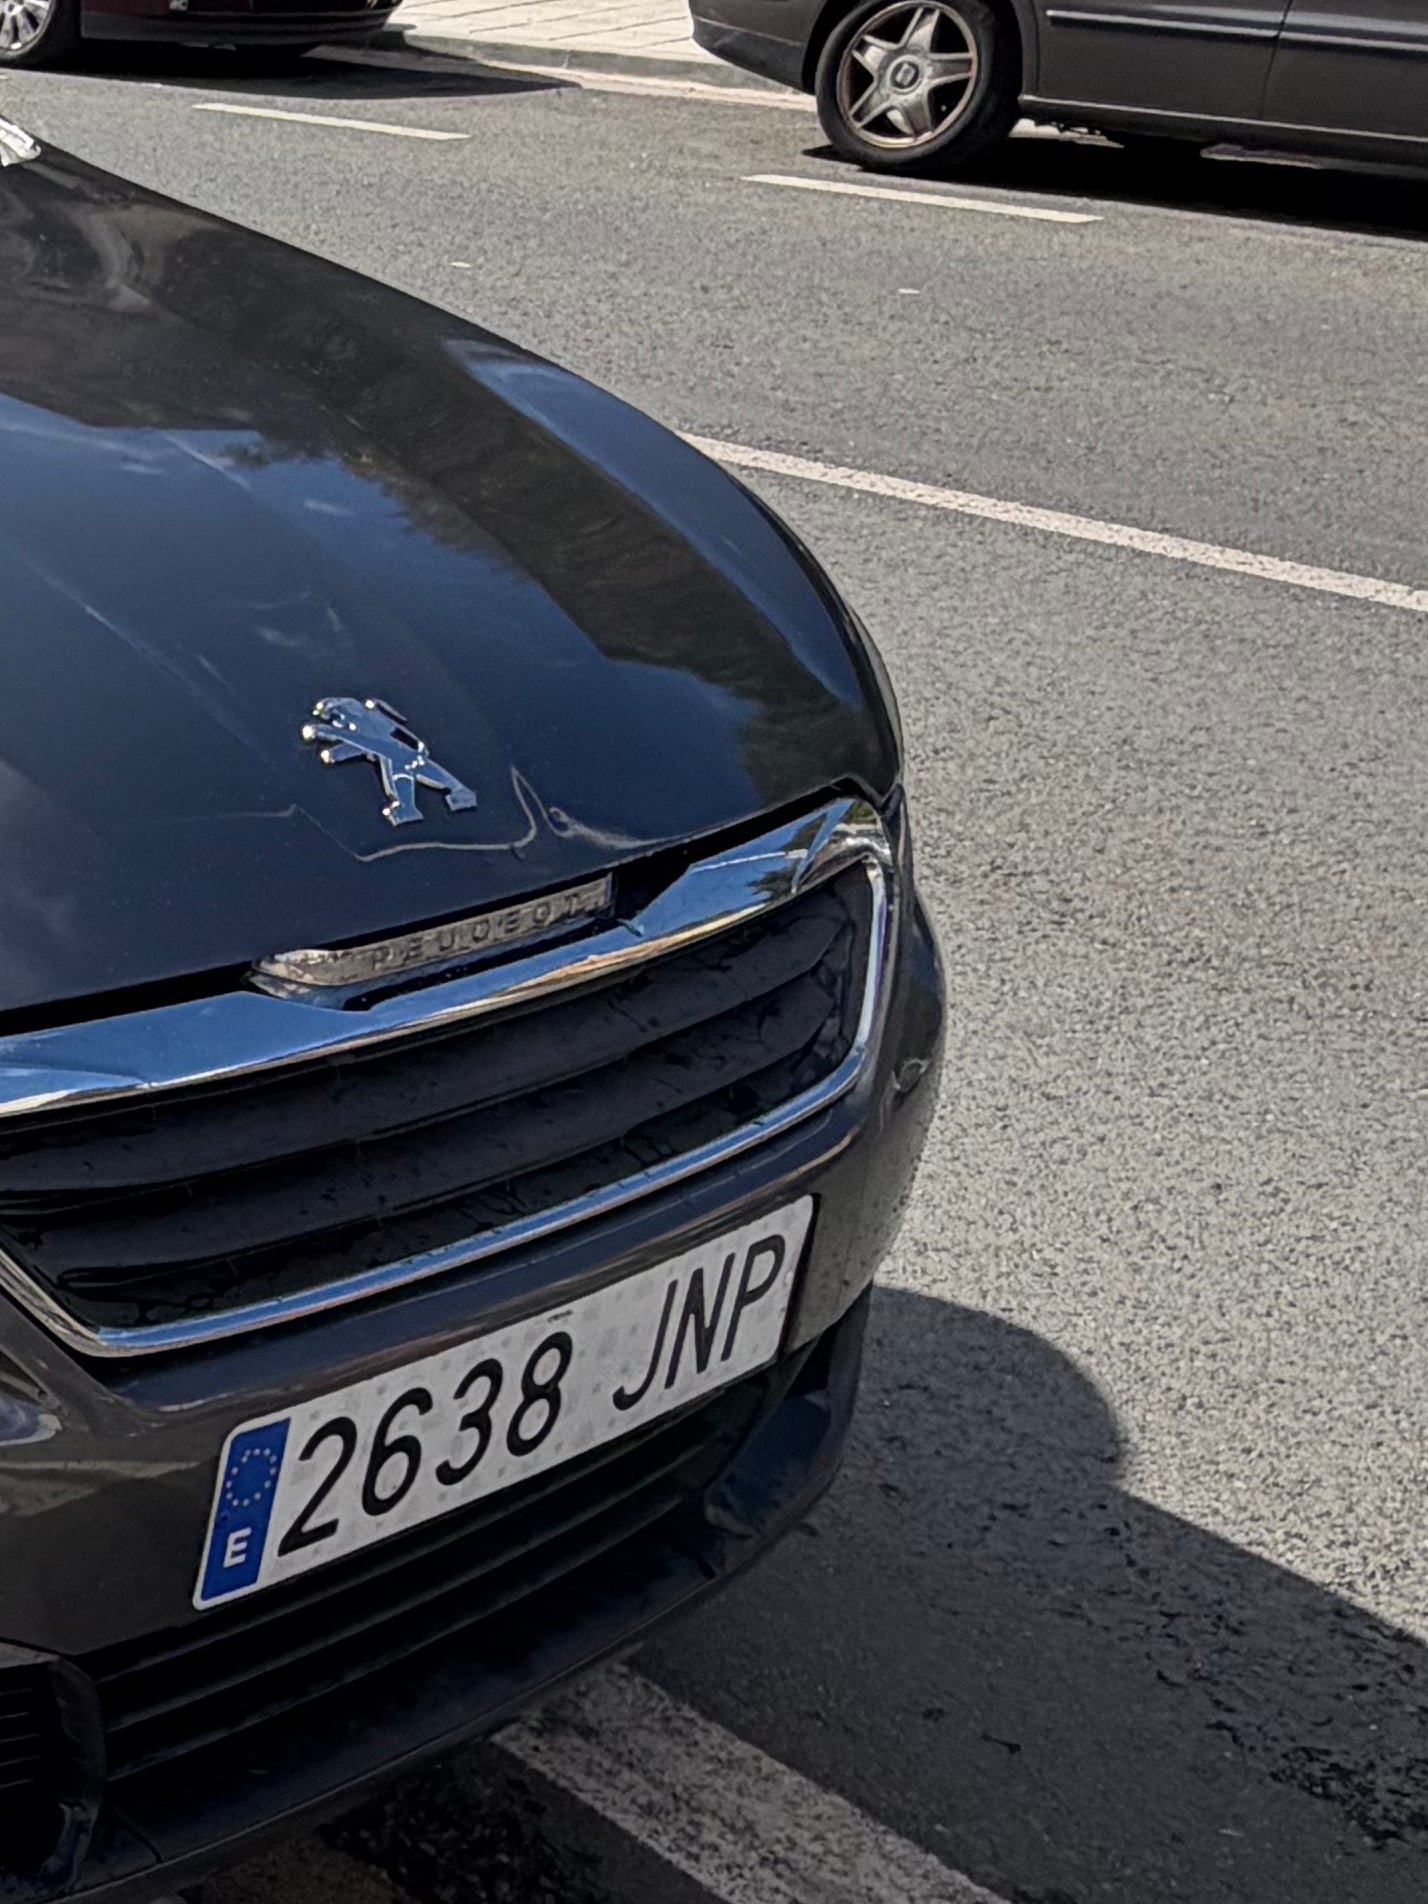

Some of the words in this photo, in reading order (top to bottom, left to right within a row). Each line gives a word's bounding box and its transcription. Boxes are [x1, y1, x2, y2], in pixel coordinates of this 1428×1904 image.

[277, 1331, 574, 1558] 2638
[612, 1233, 786, 1412] JNP
[223, 1526, 252, 1568] E
